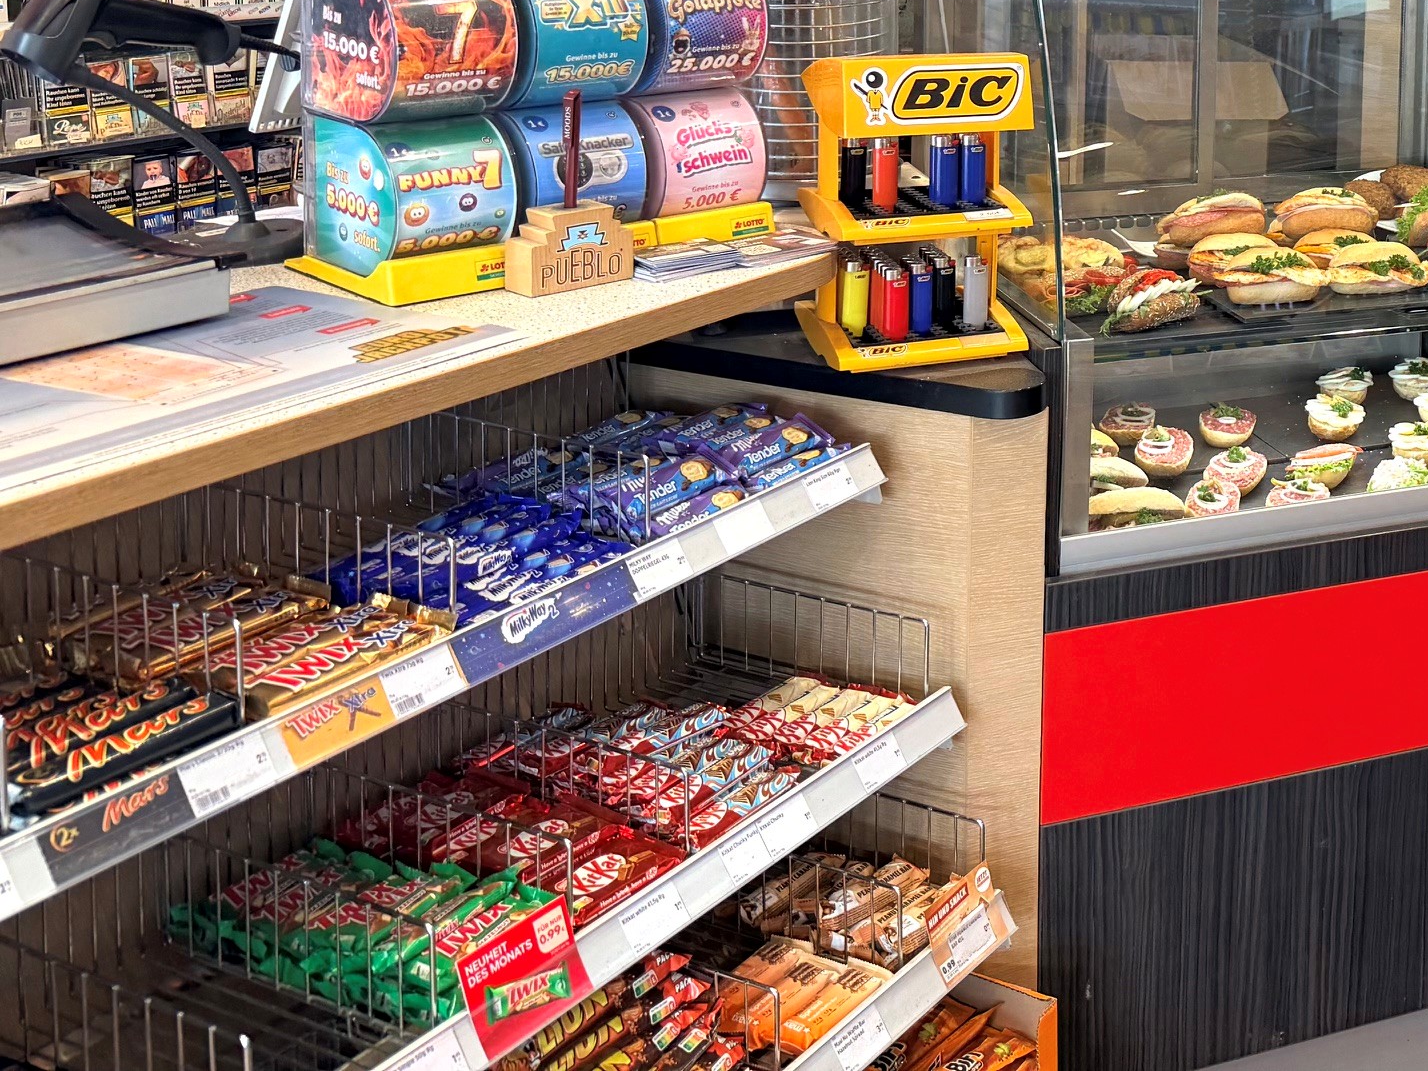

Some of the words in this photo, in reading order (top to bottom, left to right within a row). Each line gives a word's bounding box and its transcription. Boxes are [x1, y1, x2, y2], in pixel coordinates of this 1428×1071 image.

[323, 31, 368, 60] 15.000
[435, 0, 478, 64] 7
[424, 71, 461, 80] Gewinne
[461, 69, 475, 77] bis
[667, 55, 737, 74] 25.000
[406, 79, 483, 97] 15.000
[54, 119, 86, 135] Pepe
[563, 106, 571, 139] MOODS
[398, 165, 484, 192] FUNNY
[473, 149, 503, 190] 7
[683, 144, 749, 174] schwein
[682, 191, 726, 210] 5.000
[729, 188, 742, 201] €
[742, 218, 765, 227] LOTTO
[354, 230, 381, 253] sofort.
[541, 248, 622, 290] PUEBLO
[709, 429, 745, 446] Tender
[744, 442, 781, 464] Tender
[286, 699, 341, 738] Twix
[342, 685, 377, 712] Xtra
[67, 695, 210, 783] Mars
[102, 775, 170, 833] Mars
[574, 854, 625, 894] KitKat
[537, 922, 549, 933] FÜR
[550, 915, 563, 927] NUR
[464, 941, 508, 977] NEUHEIT
[467, 971, 490, 989] DES
[490, 938, 533, 973] MONATS
[536, 989, 609, 1055] LION
